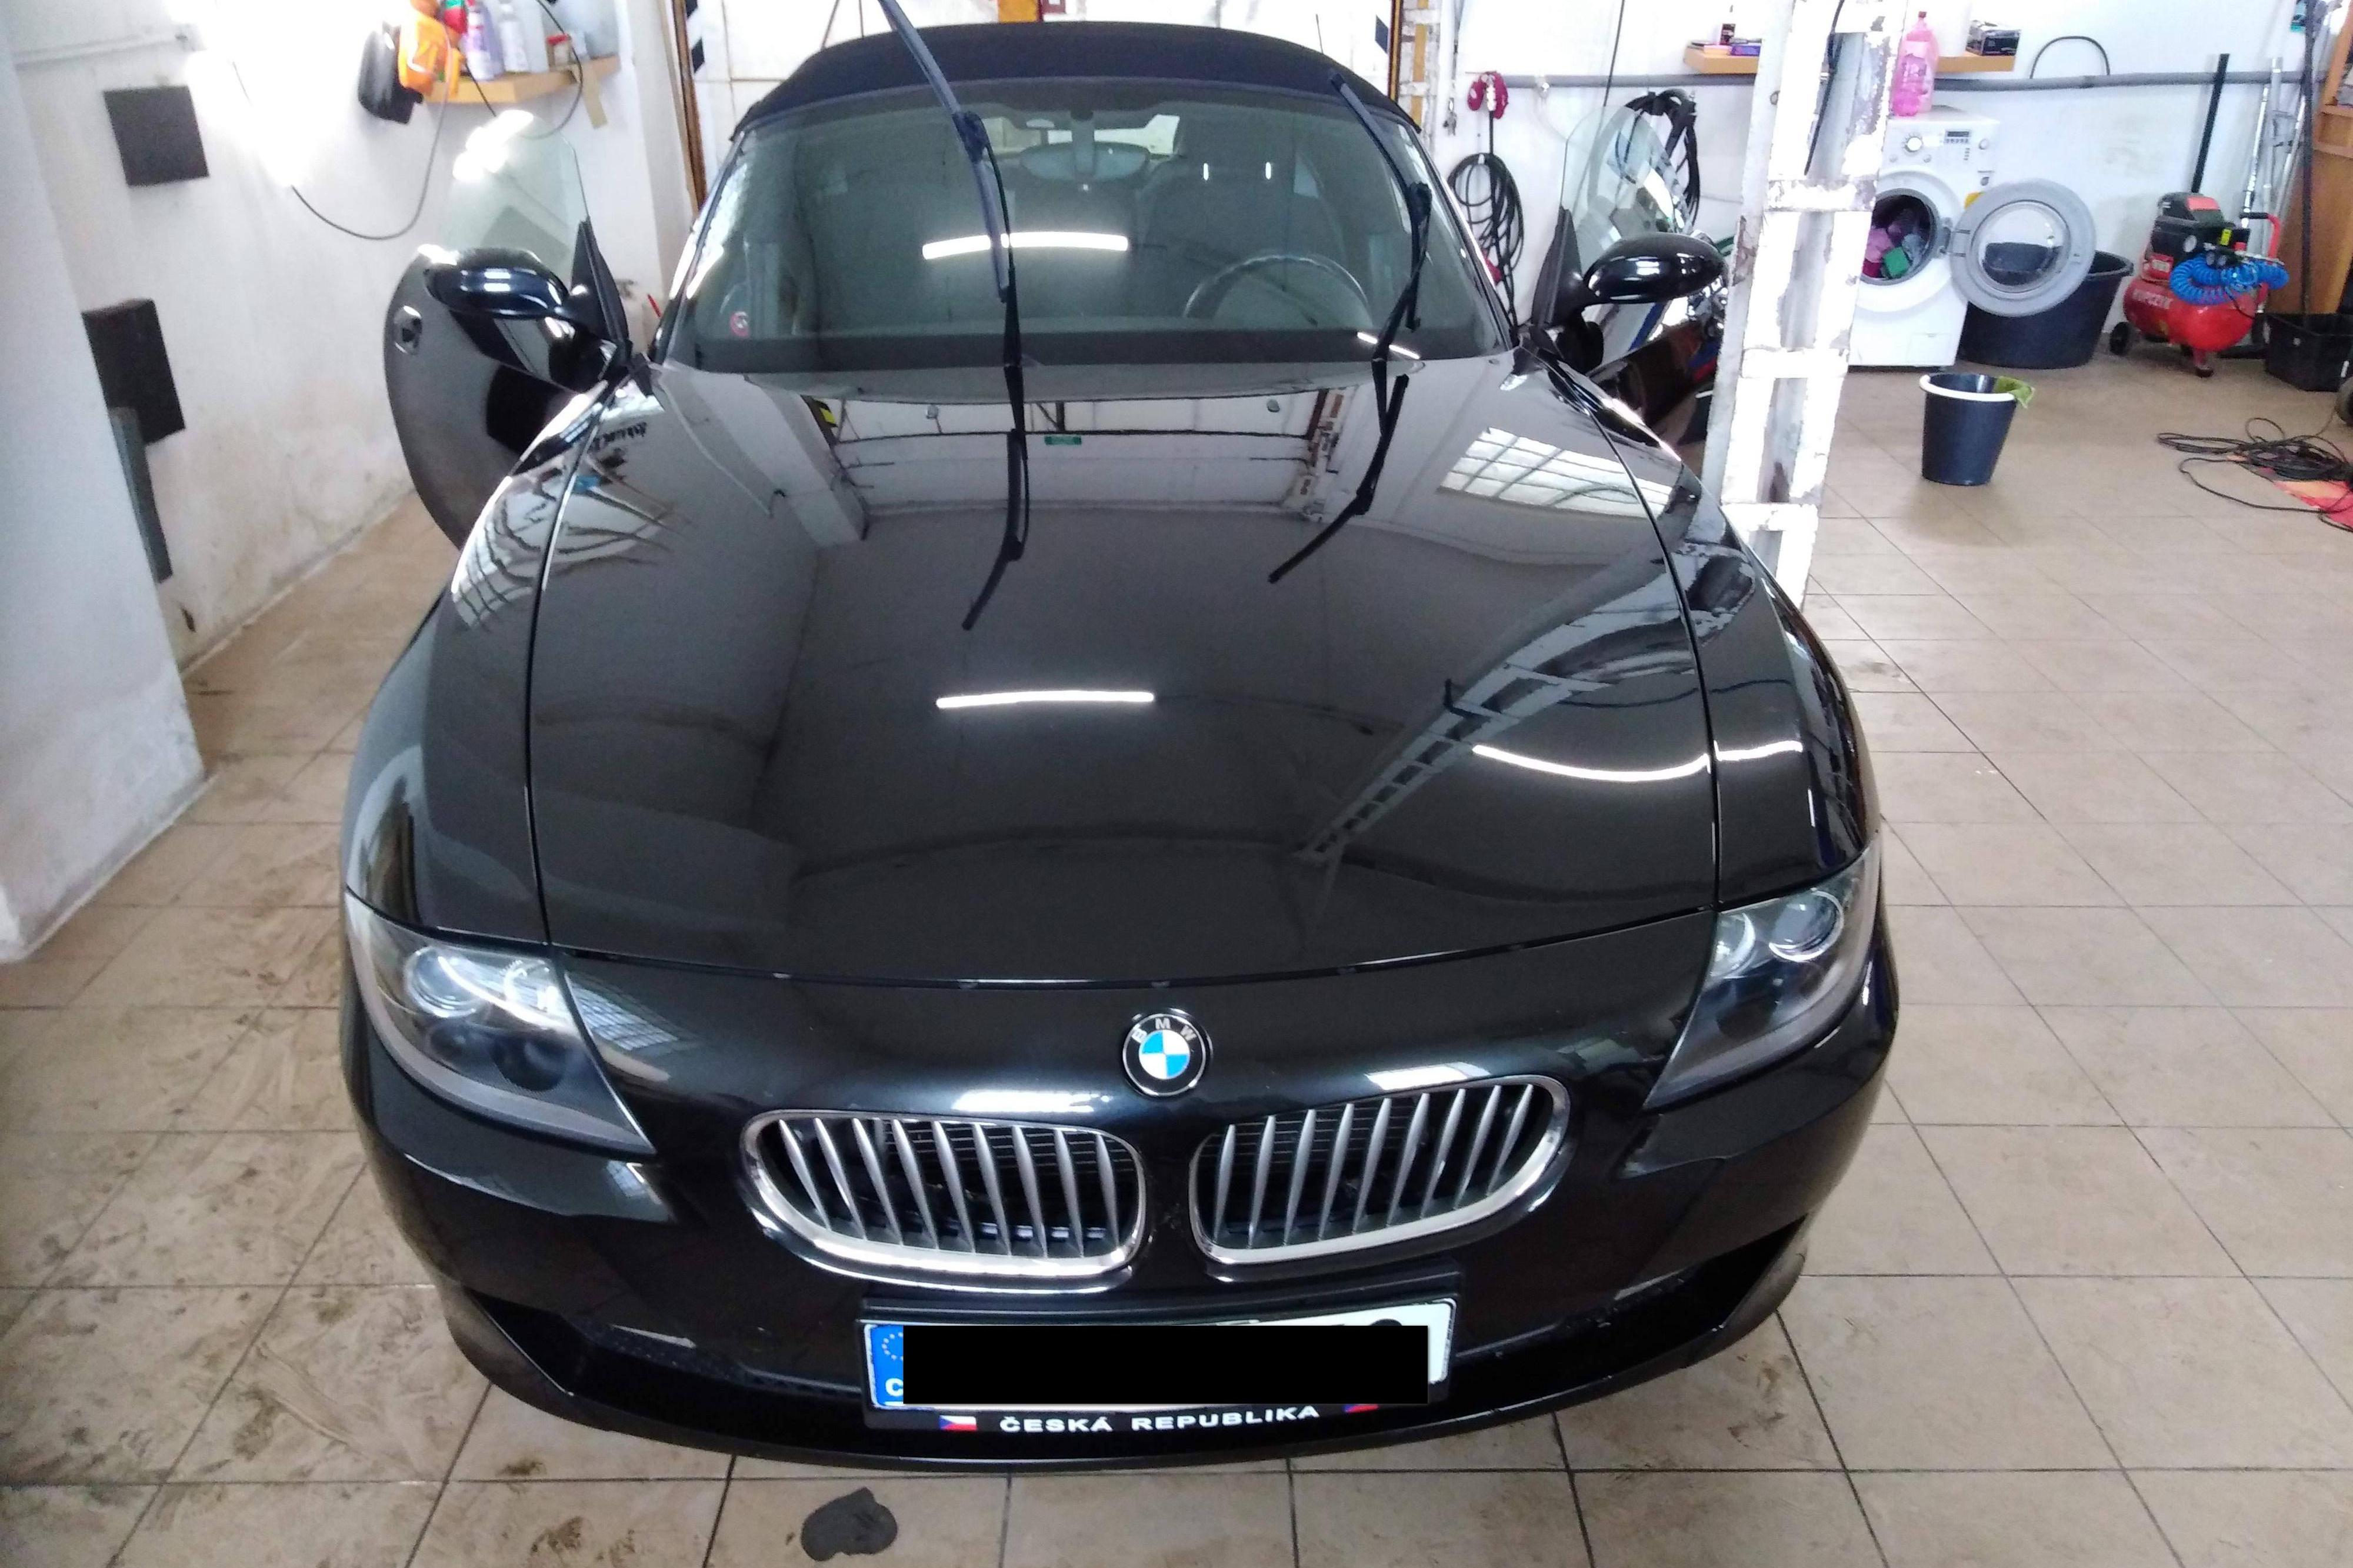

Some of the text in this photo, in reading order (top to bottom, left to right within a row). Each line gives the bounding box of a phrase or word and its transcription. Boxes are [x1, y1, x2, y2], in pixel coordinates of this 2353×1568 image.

[1131, 1017, 1197, 1043] BMW
[885, 1378, 904, 1397] C
[999, 1406, 1320, 1433] ČESKÁ REPUBLIKA
